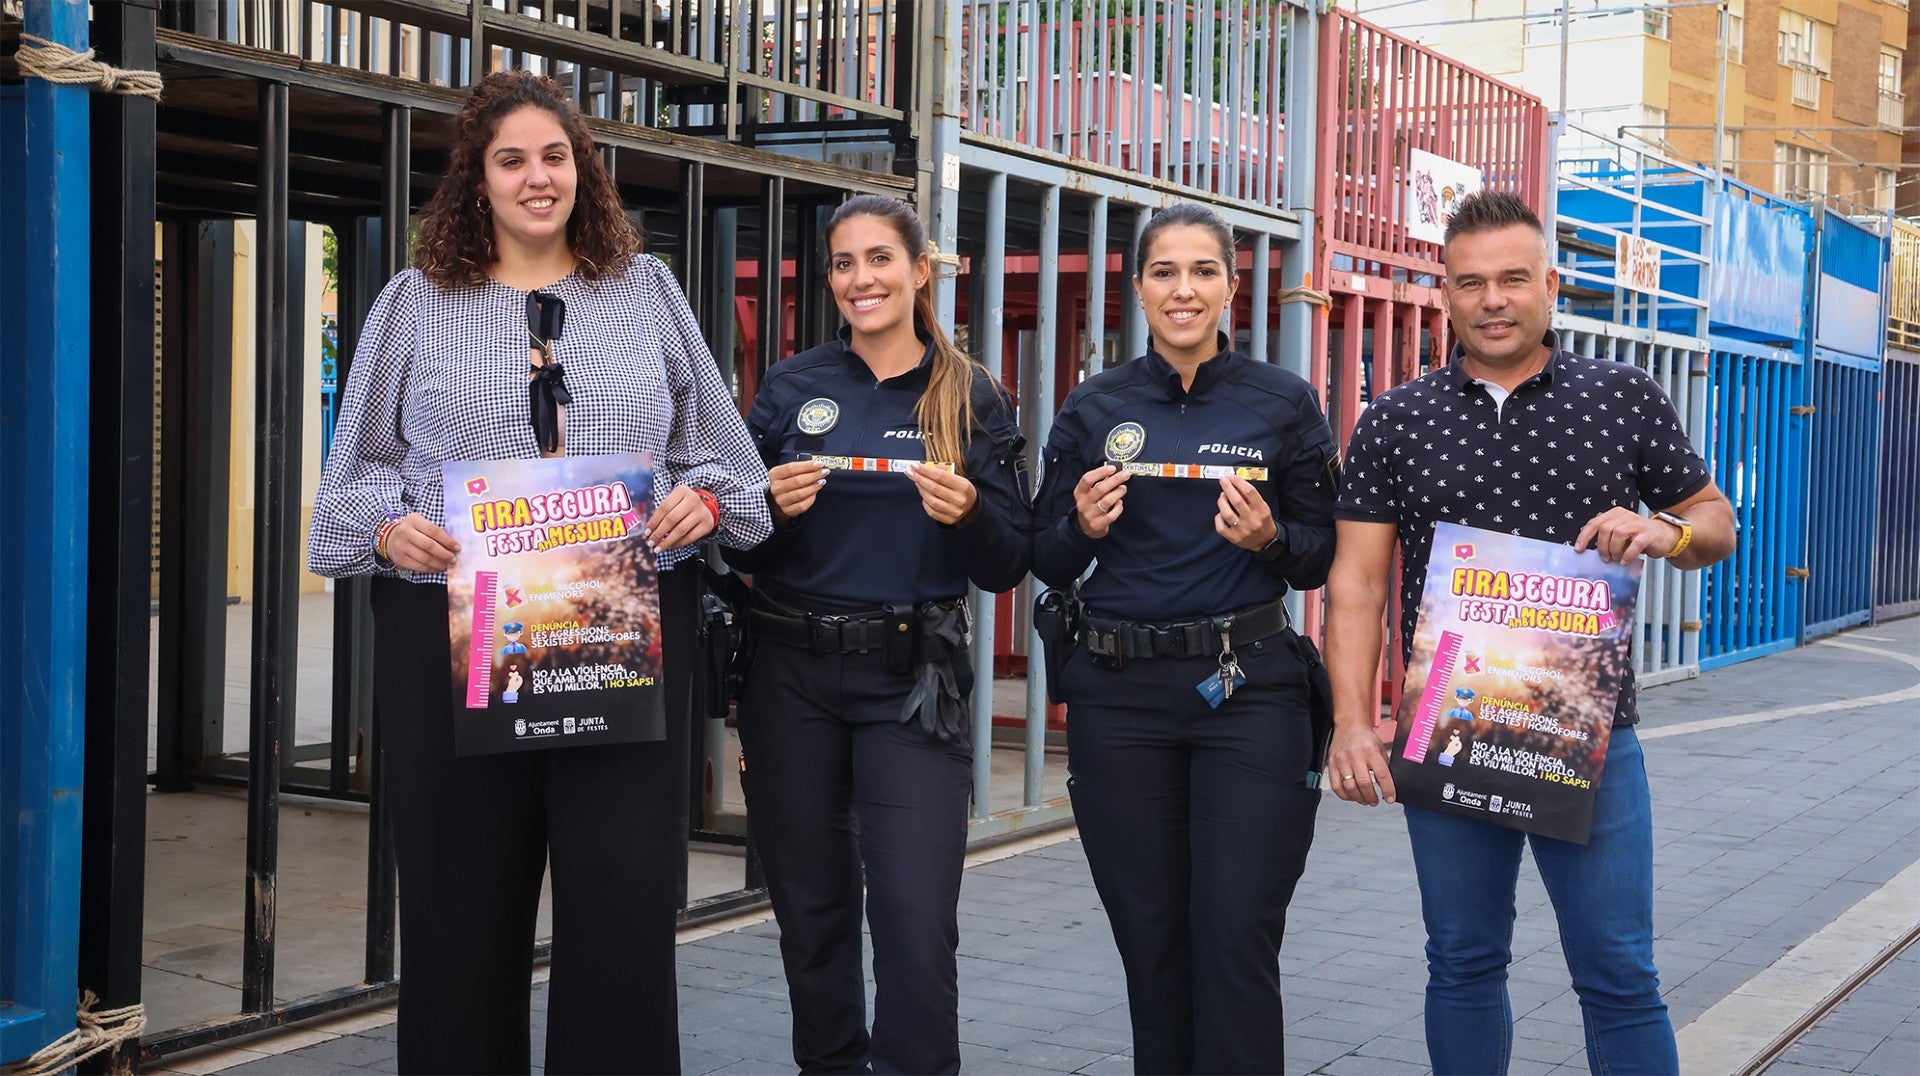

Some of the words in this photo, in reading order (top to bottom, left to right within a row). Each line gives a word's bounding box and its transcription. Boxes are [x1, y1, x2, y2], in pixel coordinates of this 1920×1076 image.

[1198, 443, 1263, 461] POLICIA
[472, 498, 532, 532] FIRA
[532, 482, 631, 523] SEGURA
[486, 528, 545, 557] FESTA
[538, 537, 558, 553] AMB
[548, 516, 627, 546] MESURA
[556, 580, 602, 591] ALCOHOL
[1452, 568, 1510, 599] FIRA
[1509, 573, 1609, 612] SEGURA
[544, 590, 584, 600] MENORS
[1458, 600, 1517, 624] FESTA
[1508, 617, 1528, 630] AMB
[1520, 606, 1600, 636] MESURA
[530, 620, 580, 632] DENÚNCIA
[531, 631, 547, 640] LES
[549, 626, 609, 638] AGRESSIONS
[532, 637, 574, 648] SEXISTES
[532, 670, 548, 678] NO
[559, 668, 571, 676] LA
[1488, 666, 1499, 674] EN
[1502, 669, 1542, 684] MENORS
[1516, 664, 1561, 679] ALCOHOL
[532, 677, 552, 687] QUE
[555, 676, 575, 684] AMB
[578, 674, 598, 682] BON
[546, 684, 563, 693] VIU
[564, 681, 603, 692] MILLOR,
[610, 679, 624, 688] HO
[626, 677, 654, 687] SAPS!
[1482, 696, 1530, 712] DENÚNCIA
[579, 716, 604, 726] JUNTA
[1478, 711, 1520, 726] SEXISTES
[1480, 704, 1496, 714] LES
[1498, 708, 1558, 727] AGRESSIONS
[528, 720, 559, 728] Ajuntament
[533, 726, 555, 734] Onda
[1472, 741, 1488, 750] NO
[1489, 745, 1496, 753] A
[1498, 746, 1510, 755] LA
[1471, 749, 1491, 759] QUE
[1494, 754, 1513, 764] AMB
[1516, 759, 1536, 768] BON
[1484, 760, 1499, 769] VIU
[1500, 763, 1538, 779] MILLOR,
[1545, 773, 1560, 782] HO
[1562, 776, 1590, 789] SAPS!
[1456, 789, 1487, 800] Ajuntament
[1460, 796, 1481, 806] Onda
[1505, 800, 1531, 812] JUNTA
[1512, 810, 1533, 818] FESTES
